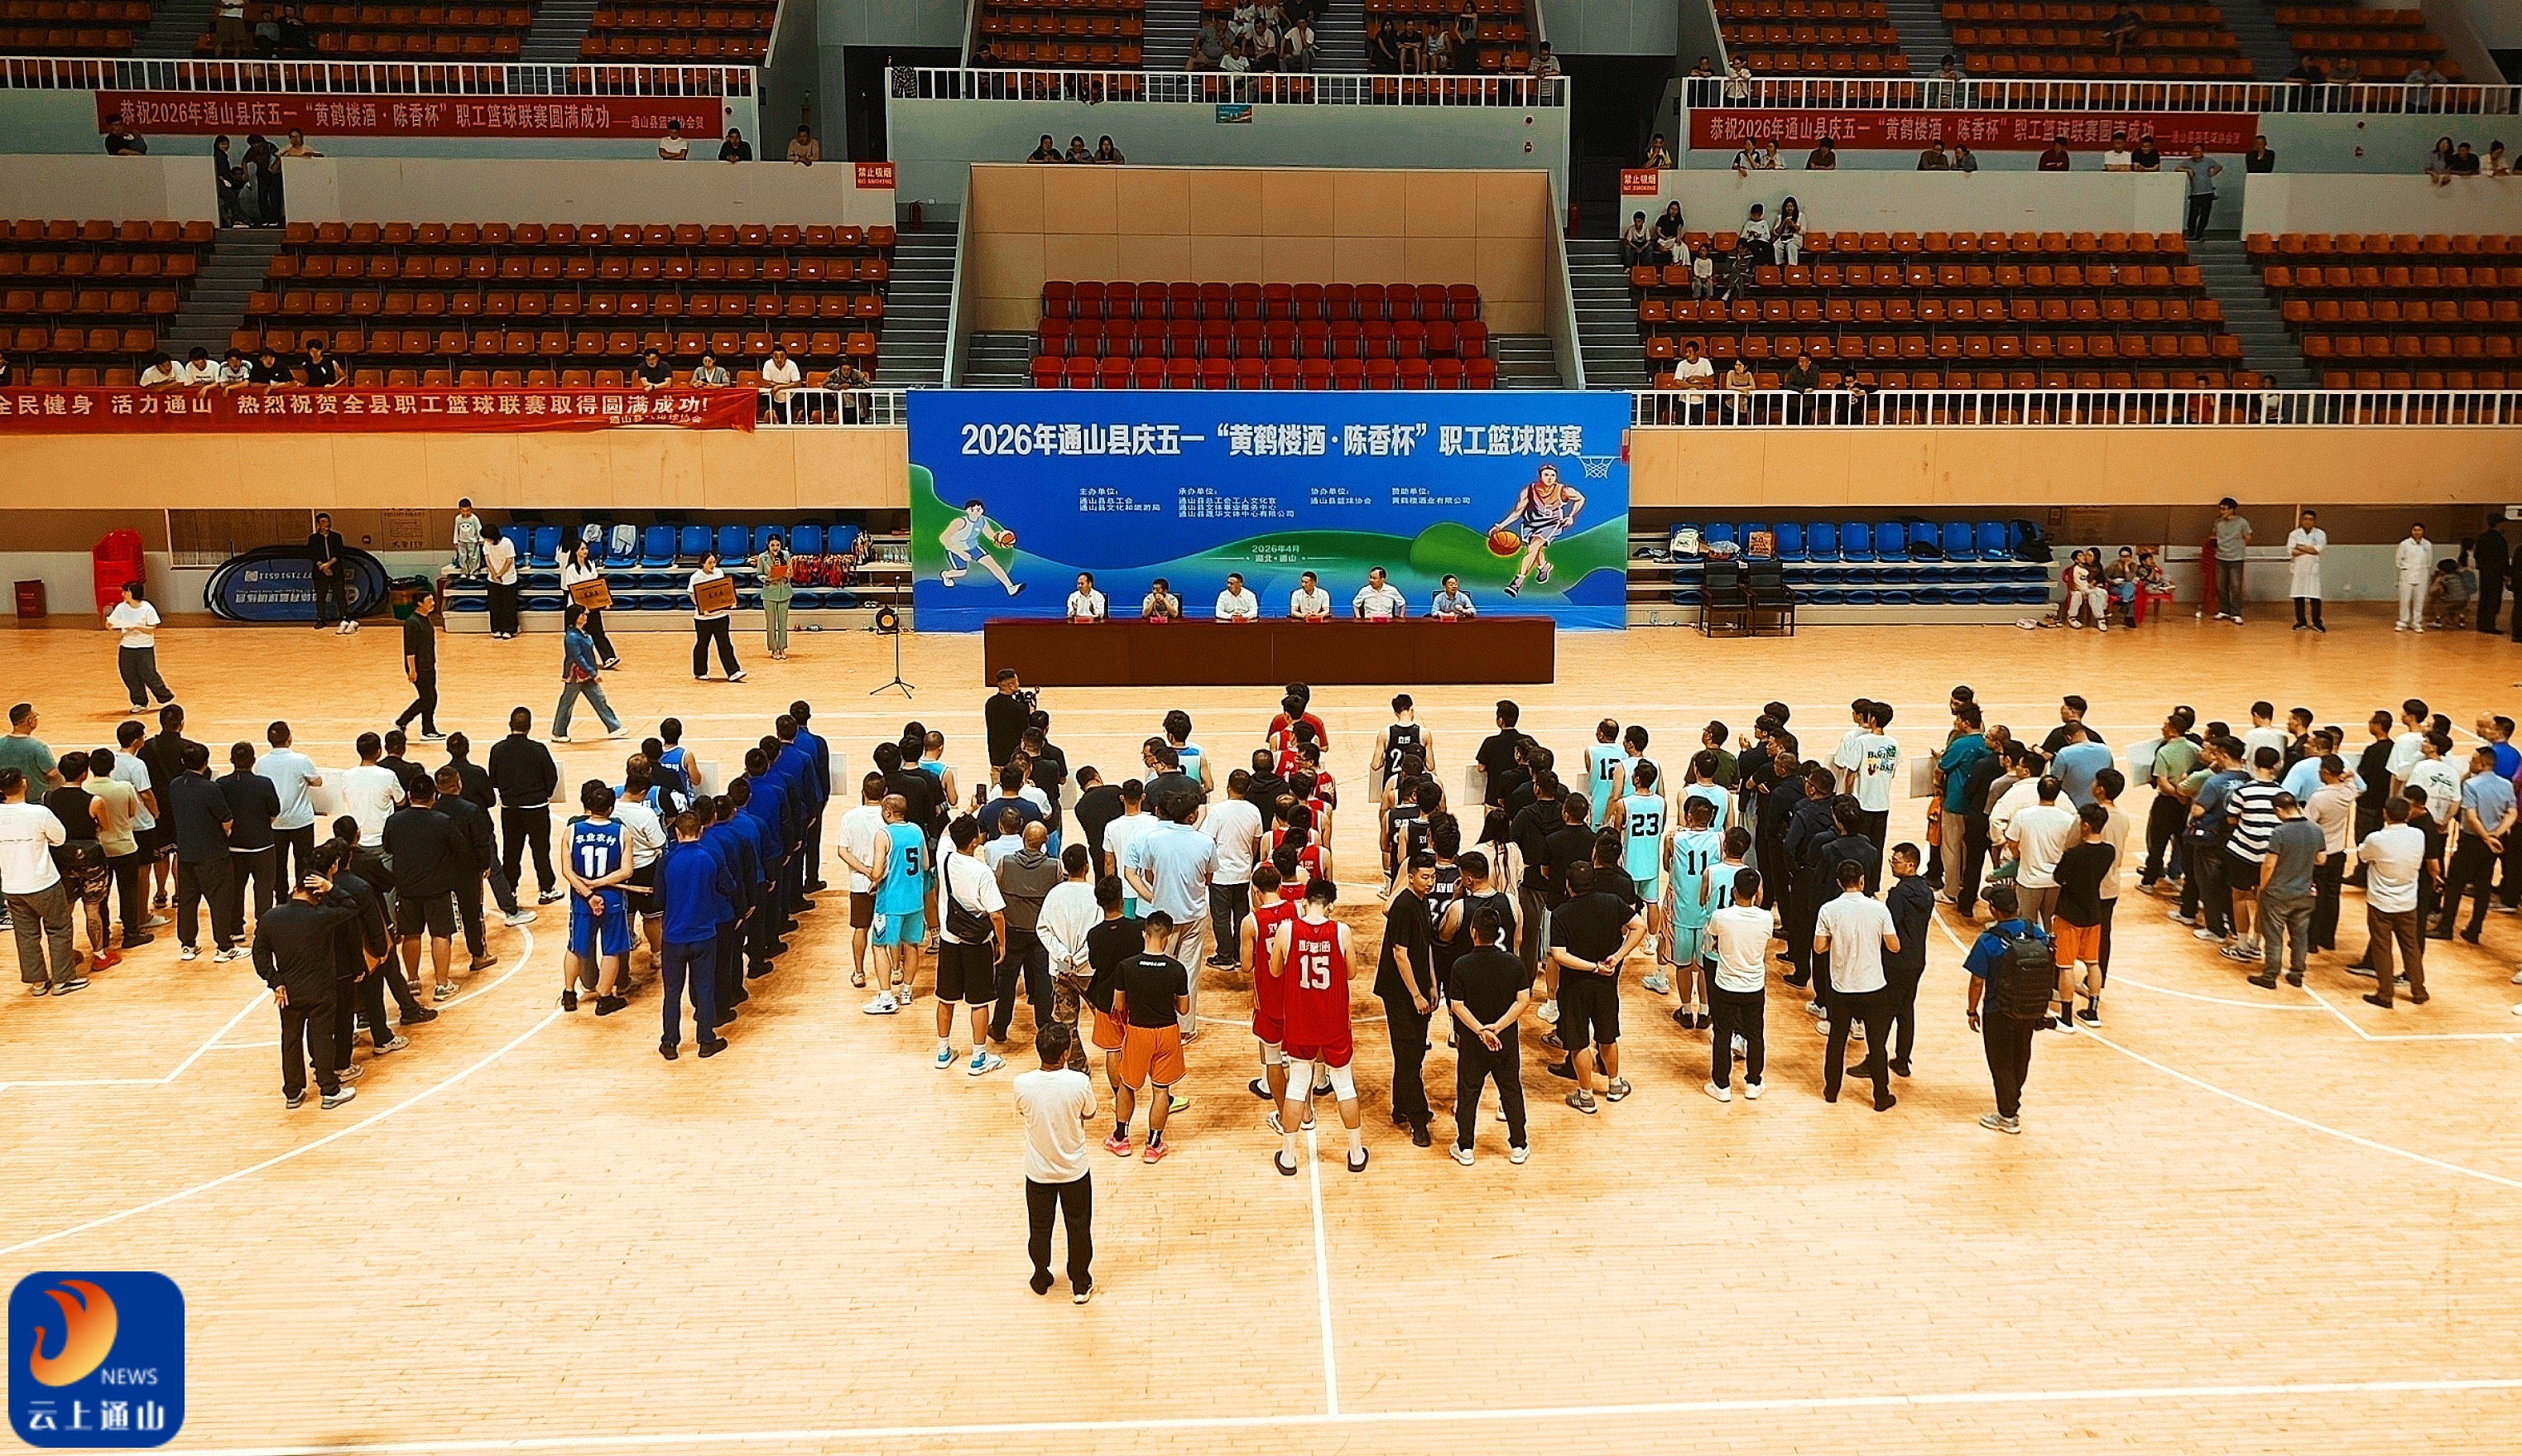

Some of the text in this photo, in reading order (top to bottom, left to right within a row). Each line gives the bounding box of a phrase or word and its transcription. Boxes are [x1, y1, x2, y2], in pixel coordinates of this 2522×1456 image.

[112, 394, 213, 414] 活力通山
[1251, 545, 1299, 553] 2026年4月
[1631, 813, 1660, 837] 23
[575, 833, 617, 847] 农业农村
[581, 845, 608, 878] 11
[905, 846, 920, 877] 5
[1687, 849, 1708, 876] 11
[1299, 954, 1331, 990] 15
